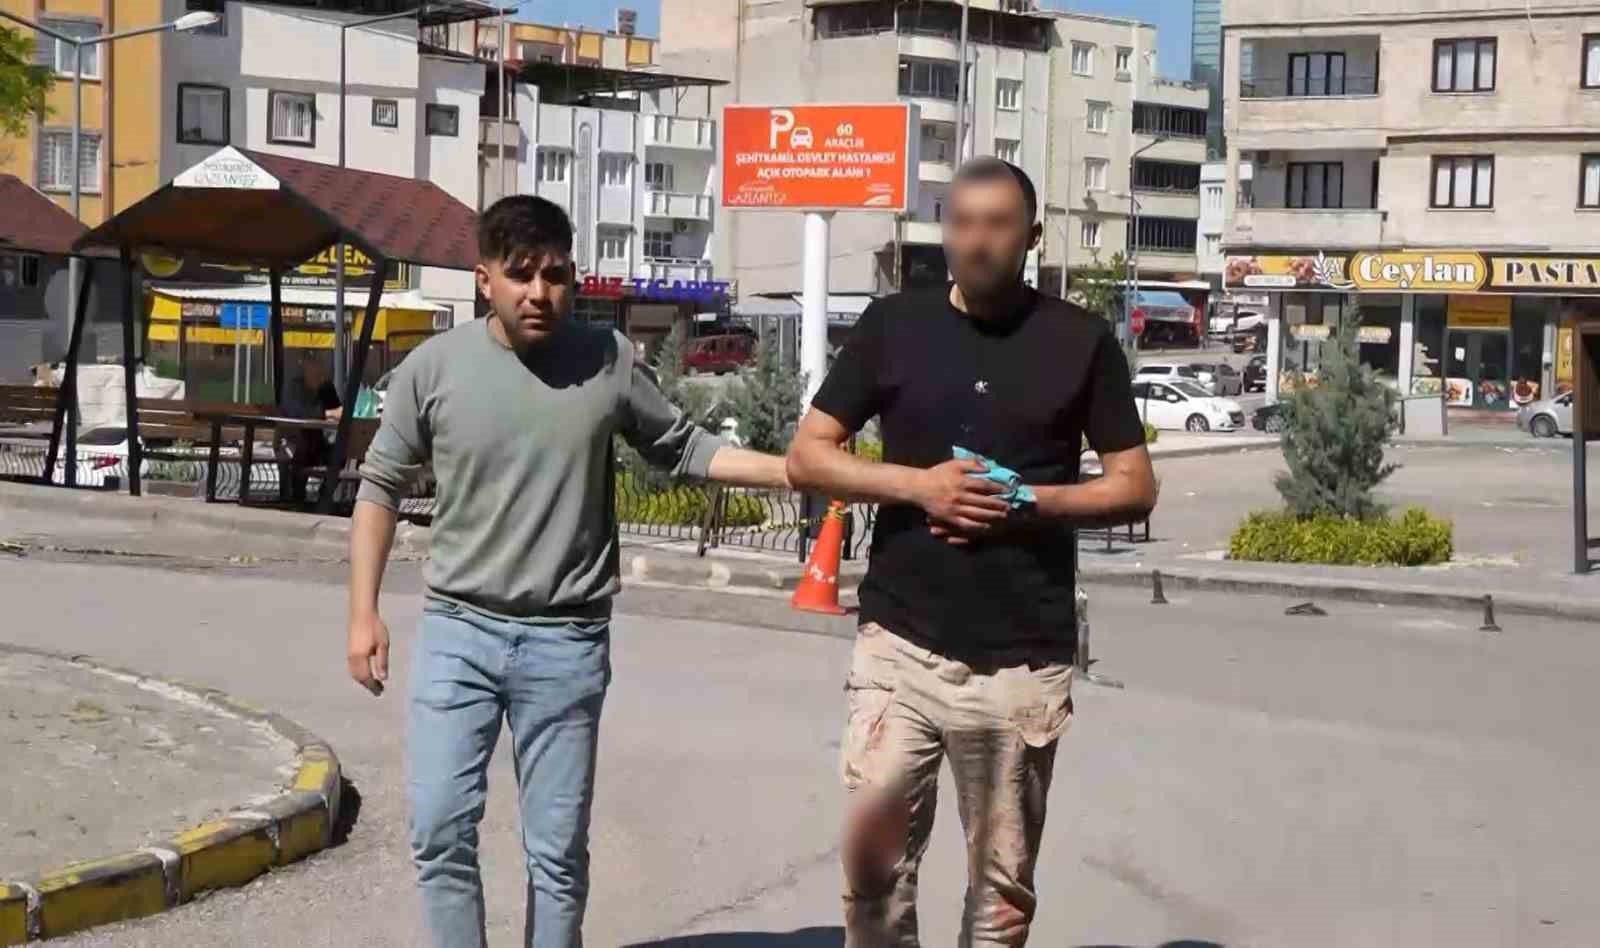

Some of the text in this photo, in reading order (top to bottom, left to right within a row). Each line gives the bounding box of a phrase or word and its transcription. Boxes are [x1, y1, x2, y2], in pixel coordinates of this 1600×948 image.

[797, 152, 838, 164] DEVLET
[782, 168, 830, 178] OTOPARK
[1360, 255, 1476, 289] Ceylan
